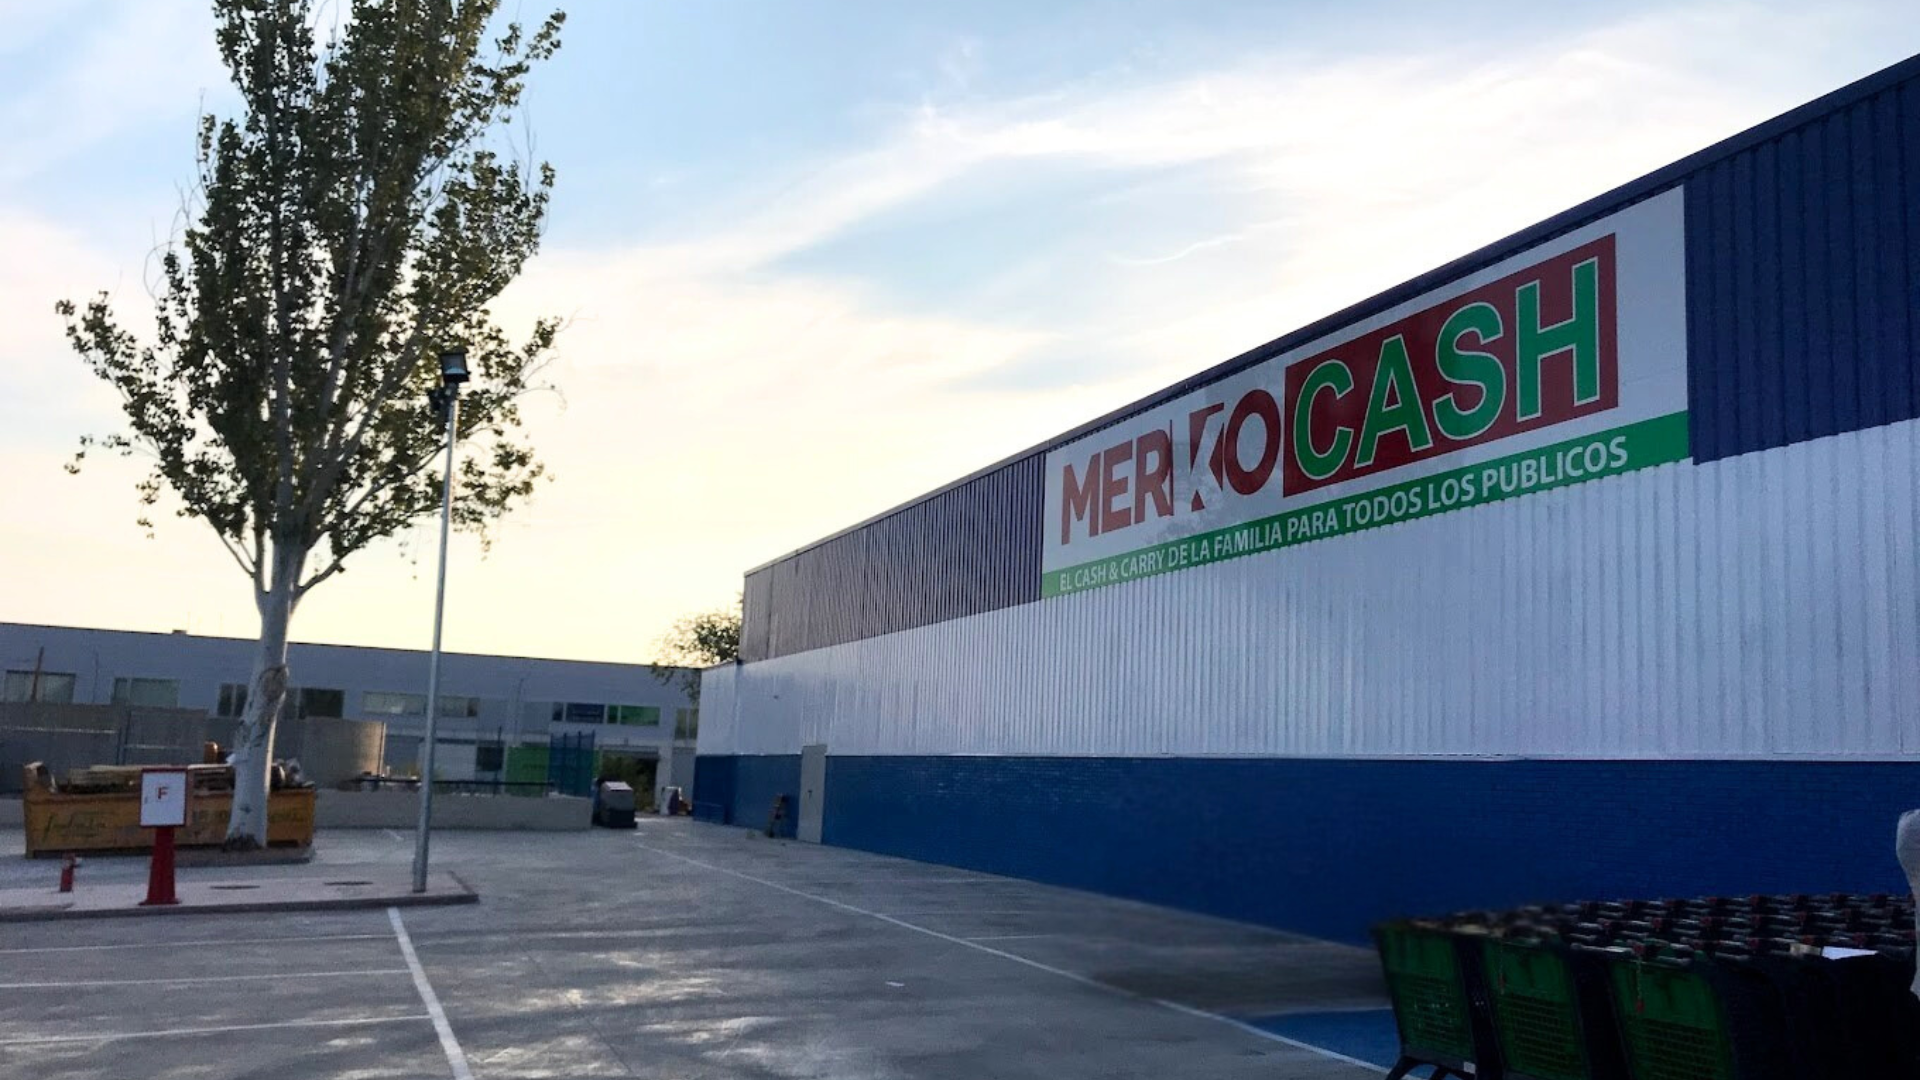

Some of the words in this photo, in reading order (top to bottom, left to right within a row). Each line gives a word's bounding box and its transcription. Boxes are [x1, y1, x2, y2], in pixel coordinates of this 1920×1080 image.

[1059, 573, 1073, 592] EL
[1074, 564, 1107, 589] CASH
[1108, 561, 1119, 581] &
[1120, 549, 1166, 577] CARRY
[1168, 546, 1188, 567] DE
[1191, 538, 1211, 564] LA
[1213, 521, 1283, 556] FAMILIA
[1287, 508, 1339, 542] PARA
[1345, 486, 1422, 528] TODOS
[1428, 473, 1475, 510] LOS
[1481, 436, 1628, 497] PUBLICOS
[157, 786, 170, 800] F
